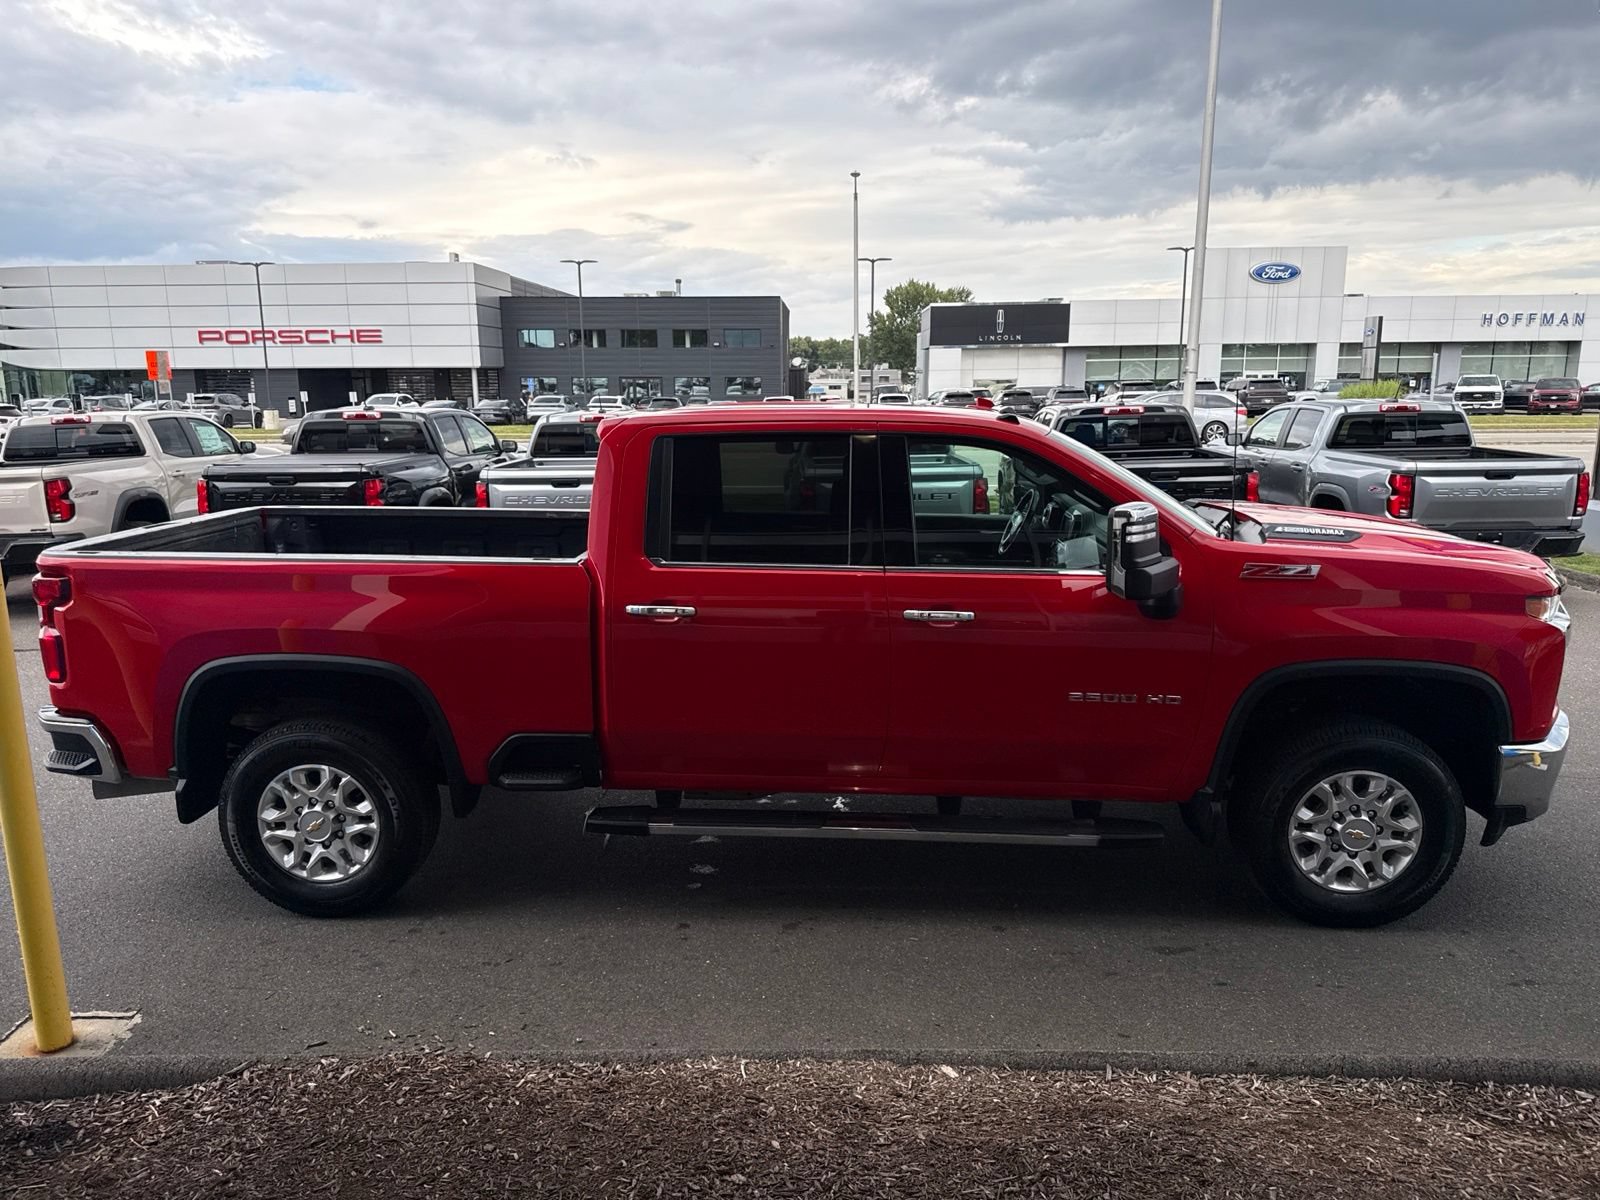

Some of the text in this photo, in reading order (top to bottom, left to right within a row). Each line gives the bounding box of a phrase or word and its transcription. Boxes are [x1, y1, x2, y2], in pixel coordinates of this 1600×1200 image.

[1261, 265, 1292, 279] Ford
[1481, 312, 1586, 327] HOFFMAN
[197, 329, 383, 345] PORSCHE
[1434, 487, 1563, 498] CHEVROLET
[505, 495, 592, 505] CHEVRO
[1304, 527, 1345, 536] DURAMAX
[1146, 694, 1182, 704] HD
